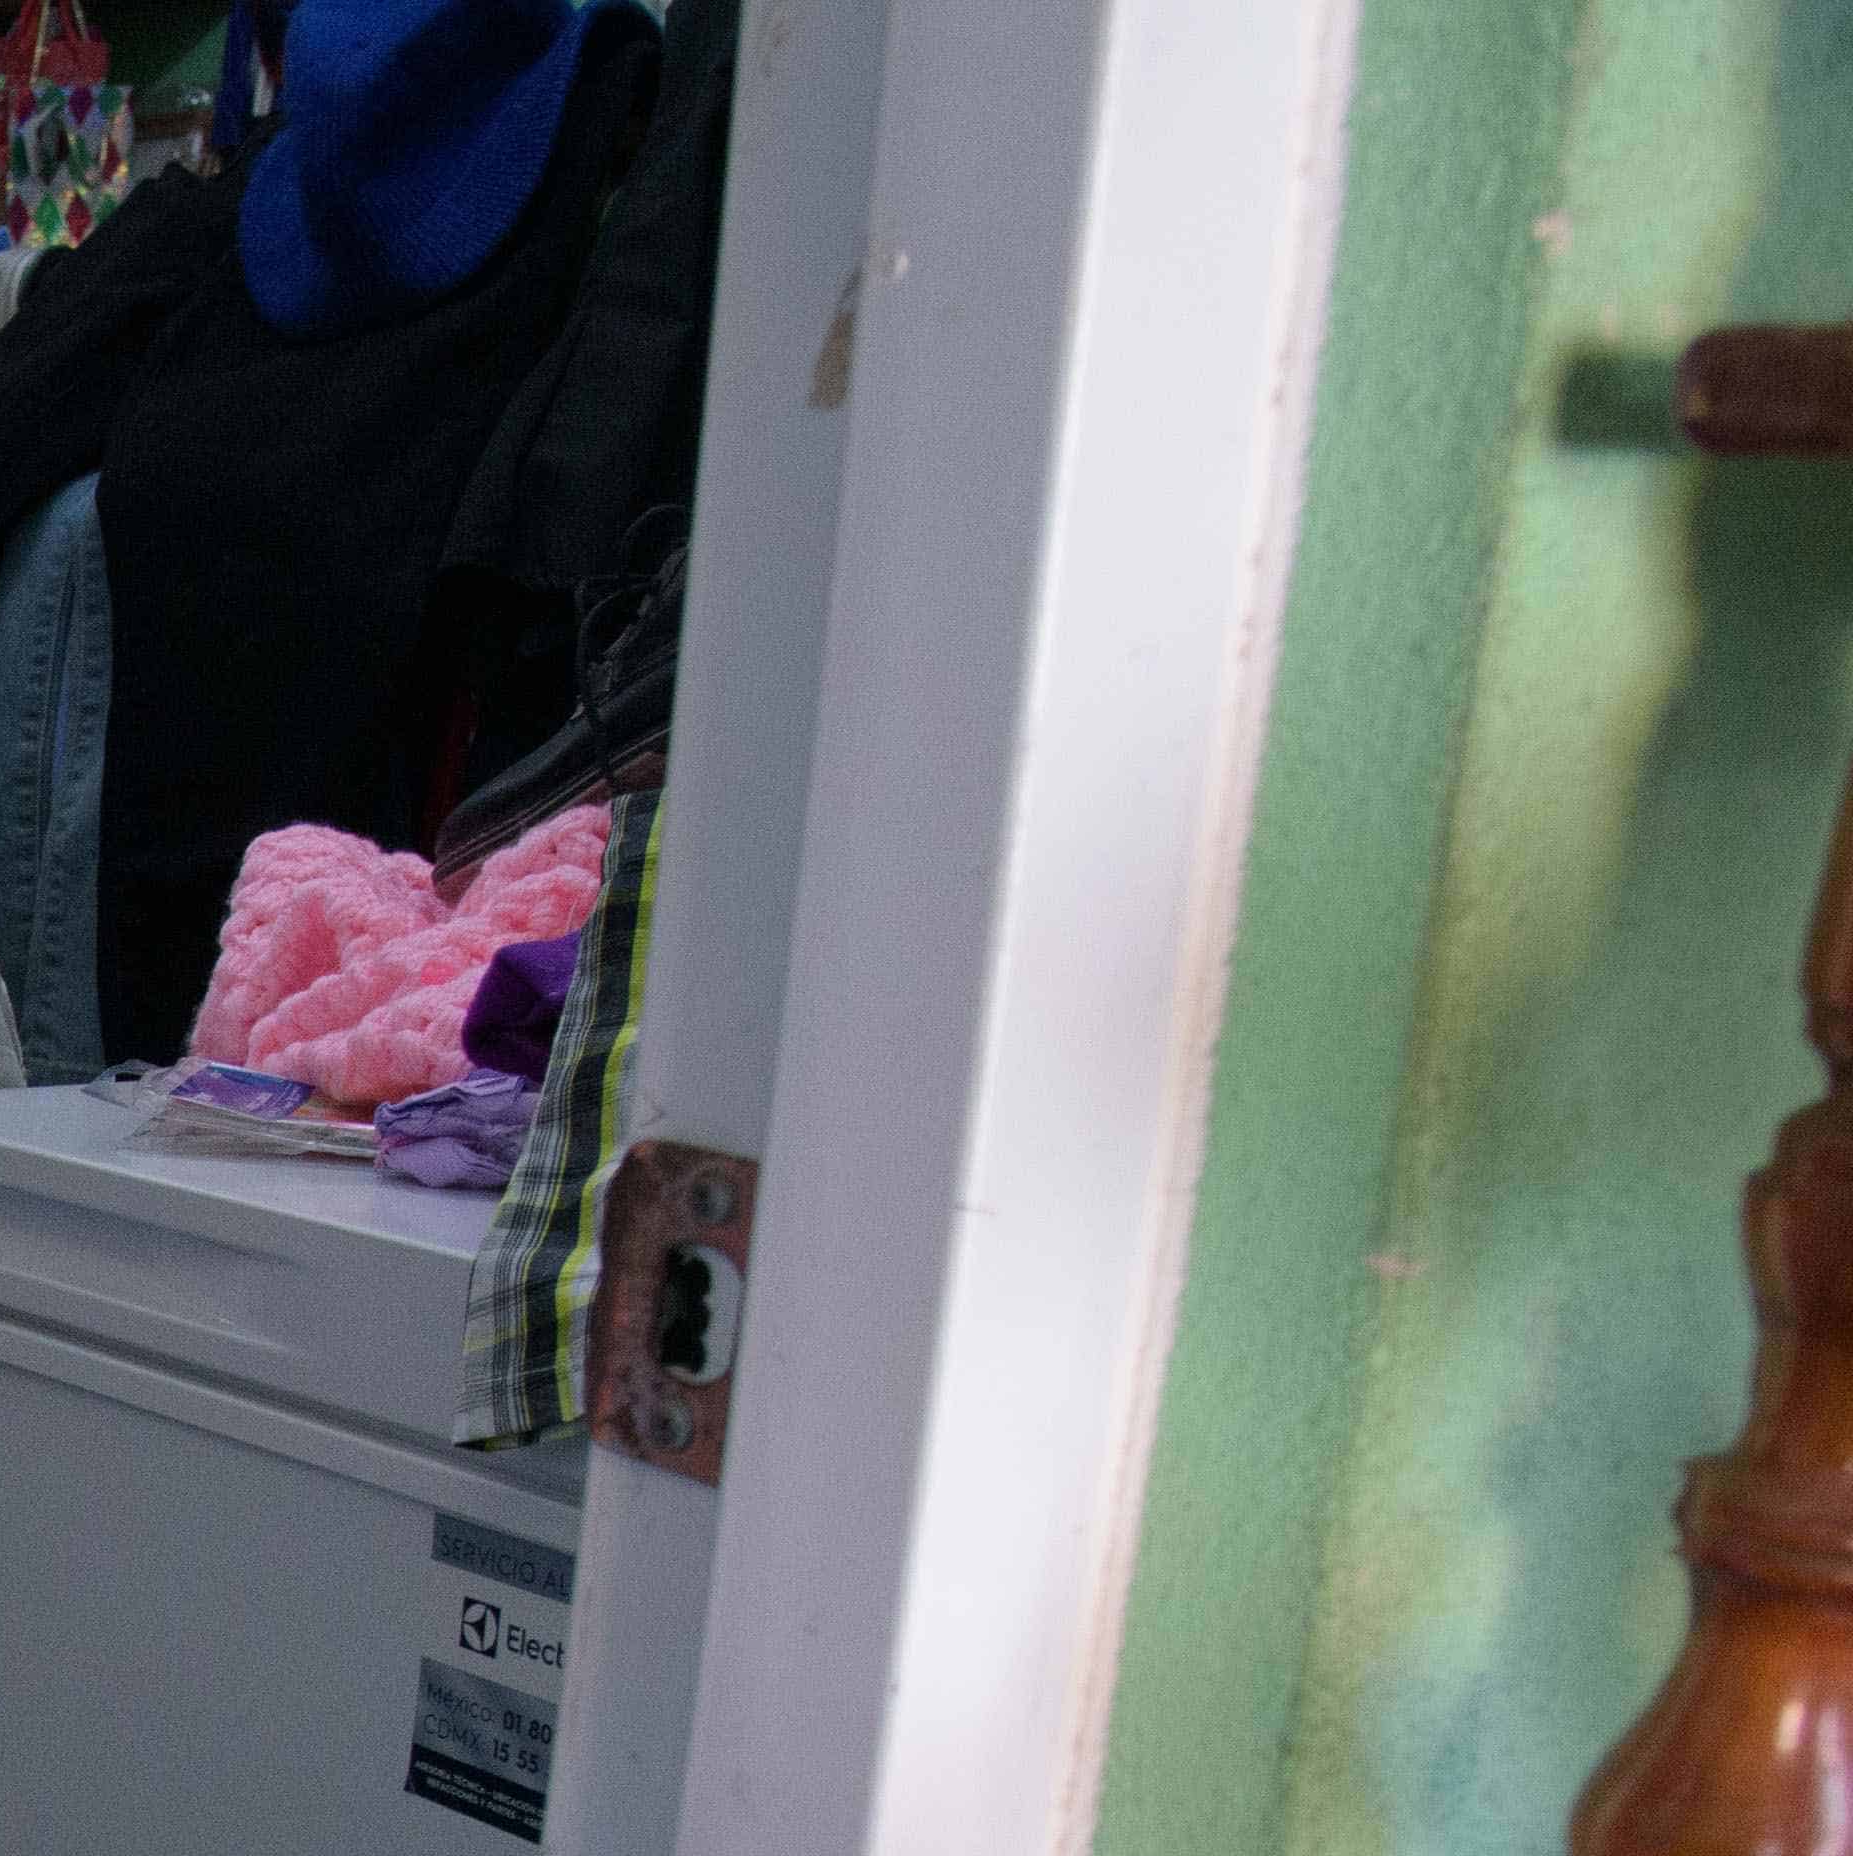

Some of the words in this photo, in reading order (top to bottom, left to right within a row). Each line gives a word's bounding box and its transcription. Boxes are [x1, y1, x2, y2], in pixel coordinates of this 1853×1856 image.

[439, 1535, 536, 1585] SERVICIO
[542, 1569, 570, 1597] AL
[503, 1710, 523, 1734] 01
[528, 1720, 552, 1745] 80
[492, 1738, 510, 1763] 15
[516, 1750, 540, 1774] 55
